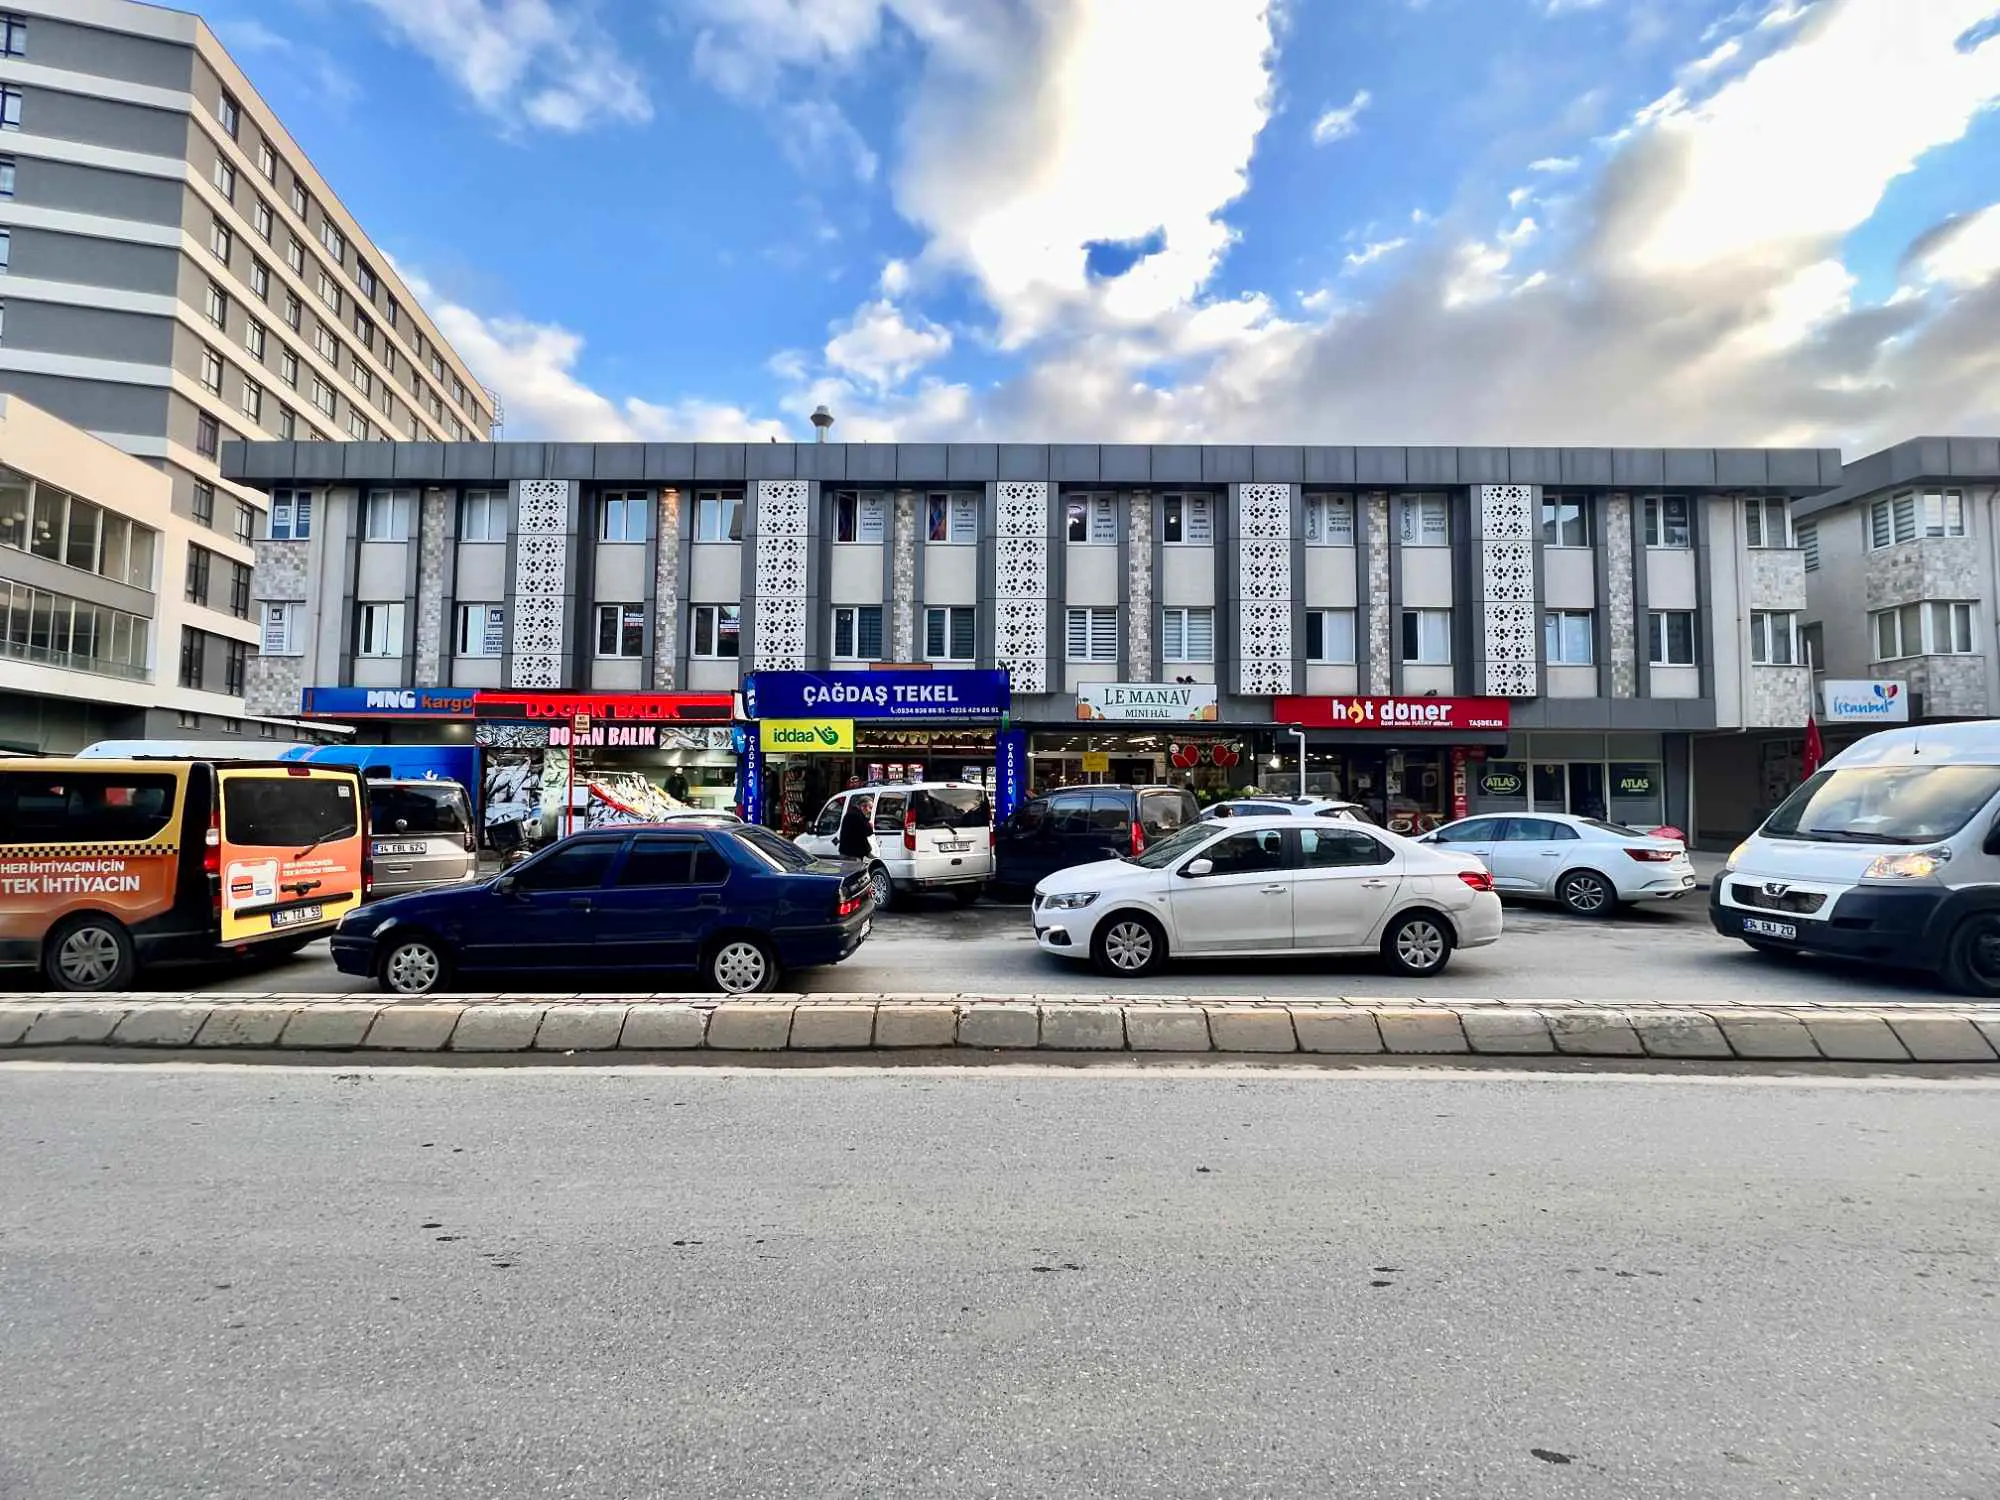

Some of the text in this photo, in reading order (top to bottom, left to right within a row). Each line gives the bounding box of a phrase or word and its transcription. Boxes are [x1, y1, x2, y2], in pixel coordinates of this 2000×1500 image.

[366, 690, 474, 712] MNG kargo
[803, 682, 959, 706] ÇAĞDAŞ TEKEL
[1104, 688, 1191, 705] LE MANAV
[1380, 700, 1453, 720] döner
[608, 726, 657, 746] BALIK
[773, 728, 814, 743] iddaa
[1486, 777, 1516, 788] ATLAS
[1620, 778, 1649, 789] ATLAS
[1, 859, 125, 875] HER İHTİYACIN İÇİN
[2, 874, 140, 894] TEK İHTİYACIN
